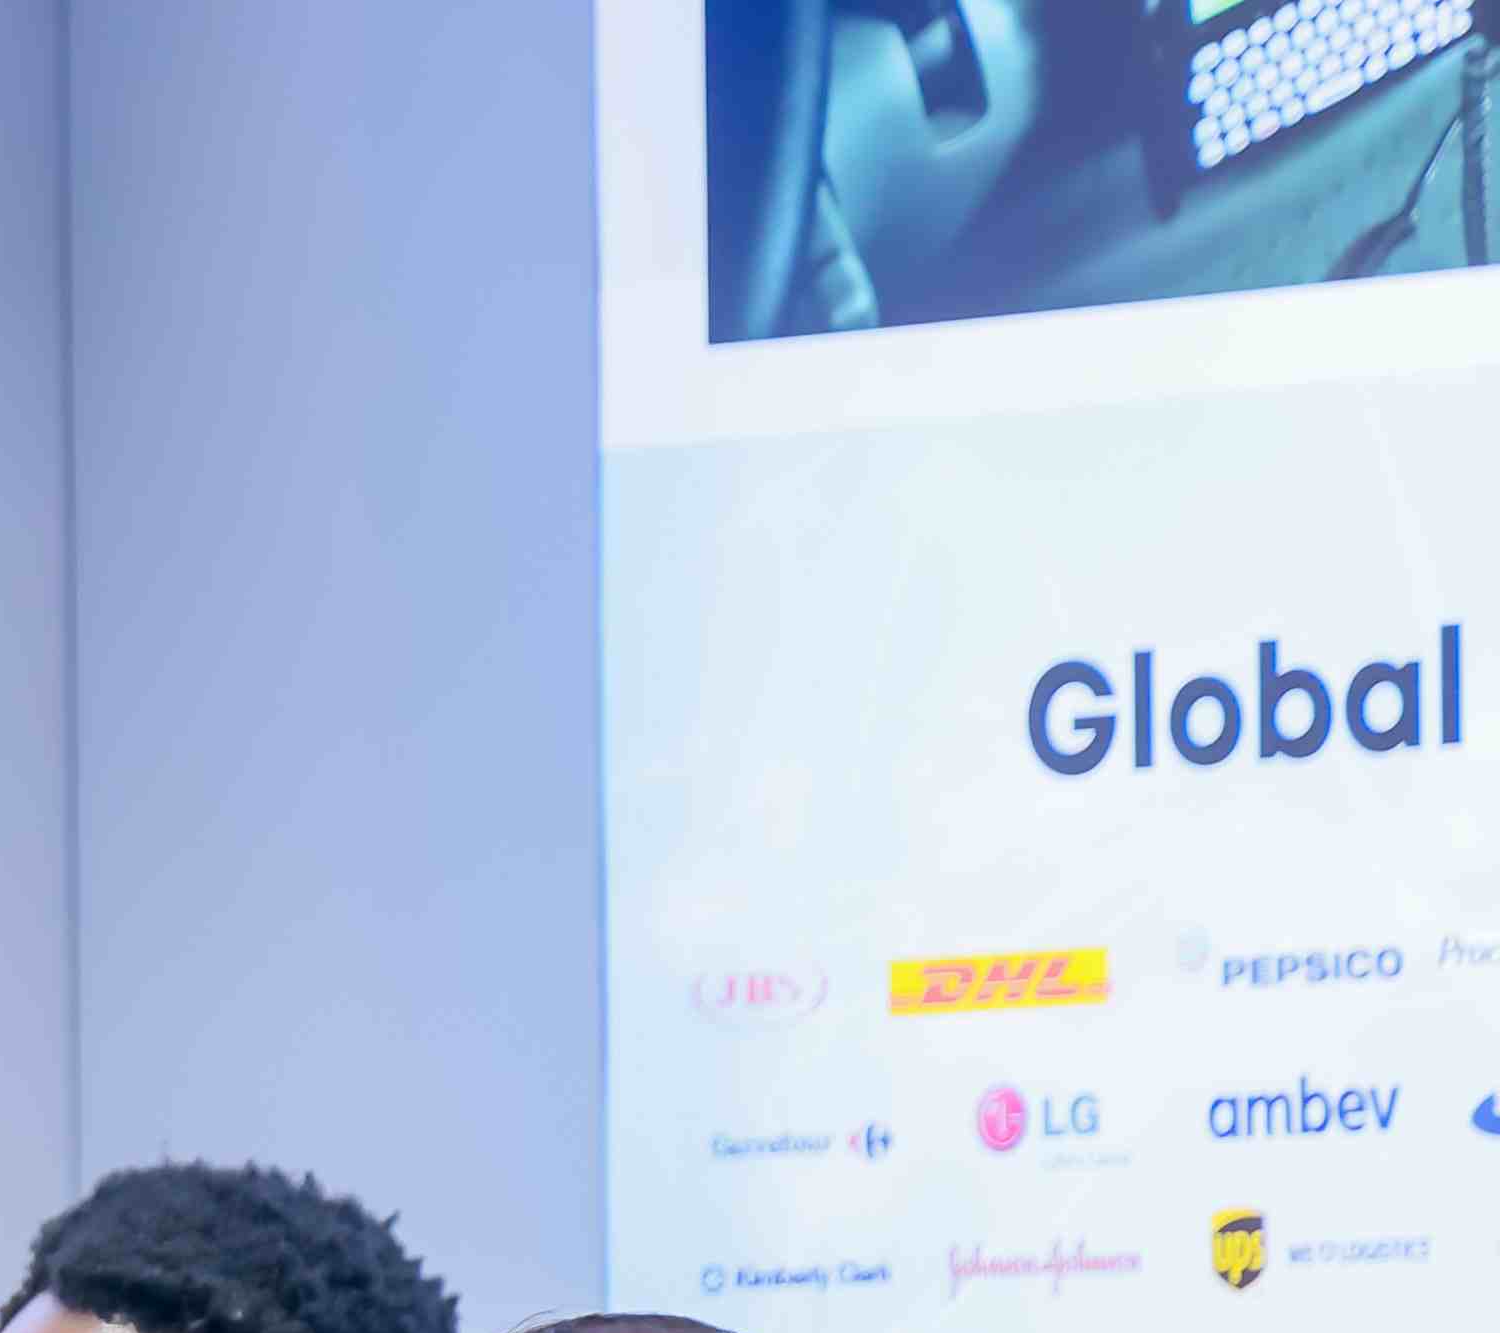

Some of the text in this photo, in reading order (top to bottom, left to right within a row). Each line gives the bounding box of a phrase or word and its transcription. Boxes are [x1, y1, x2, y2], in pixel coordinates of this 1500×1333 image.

[1028, 623, 1462, 776] Global
[922, 957, 1079, 1004] DHL
[1219, 947, 1404, 987] PEPSICO
[1043, 1093, 1100, 1136] LG
[1208, 1075, 1398, 1138] ambev
